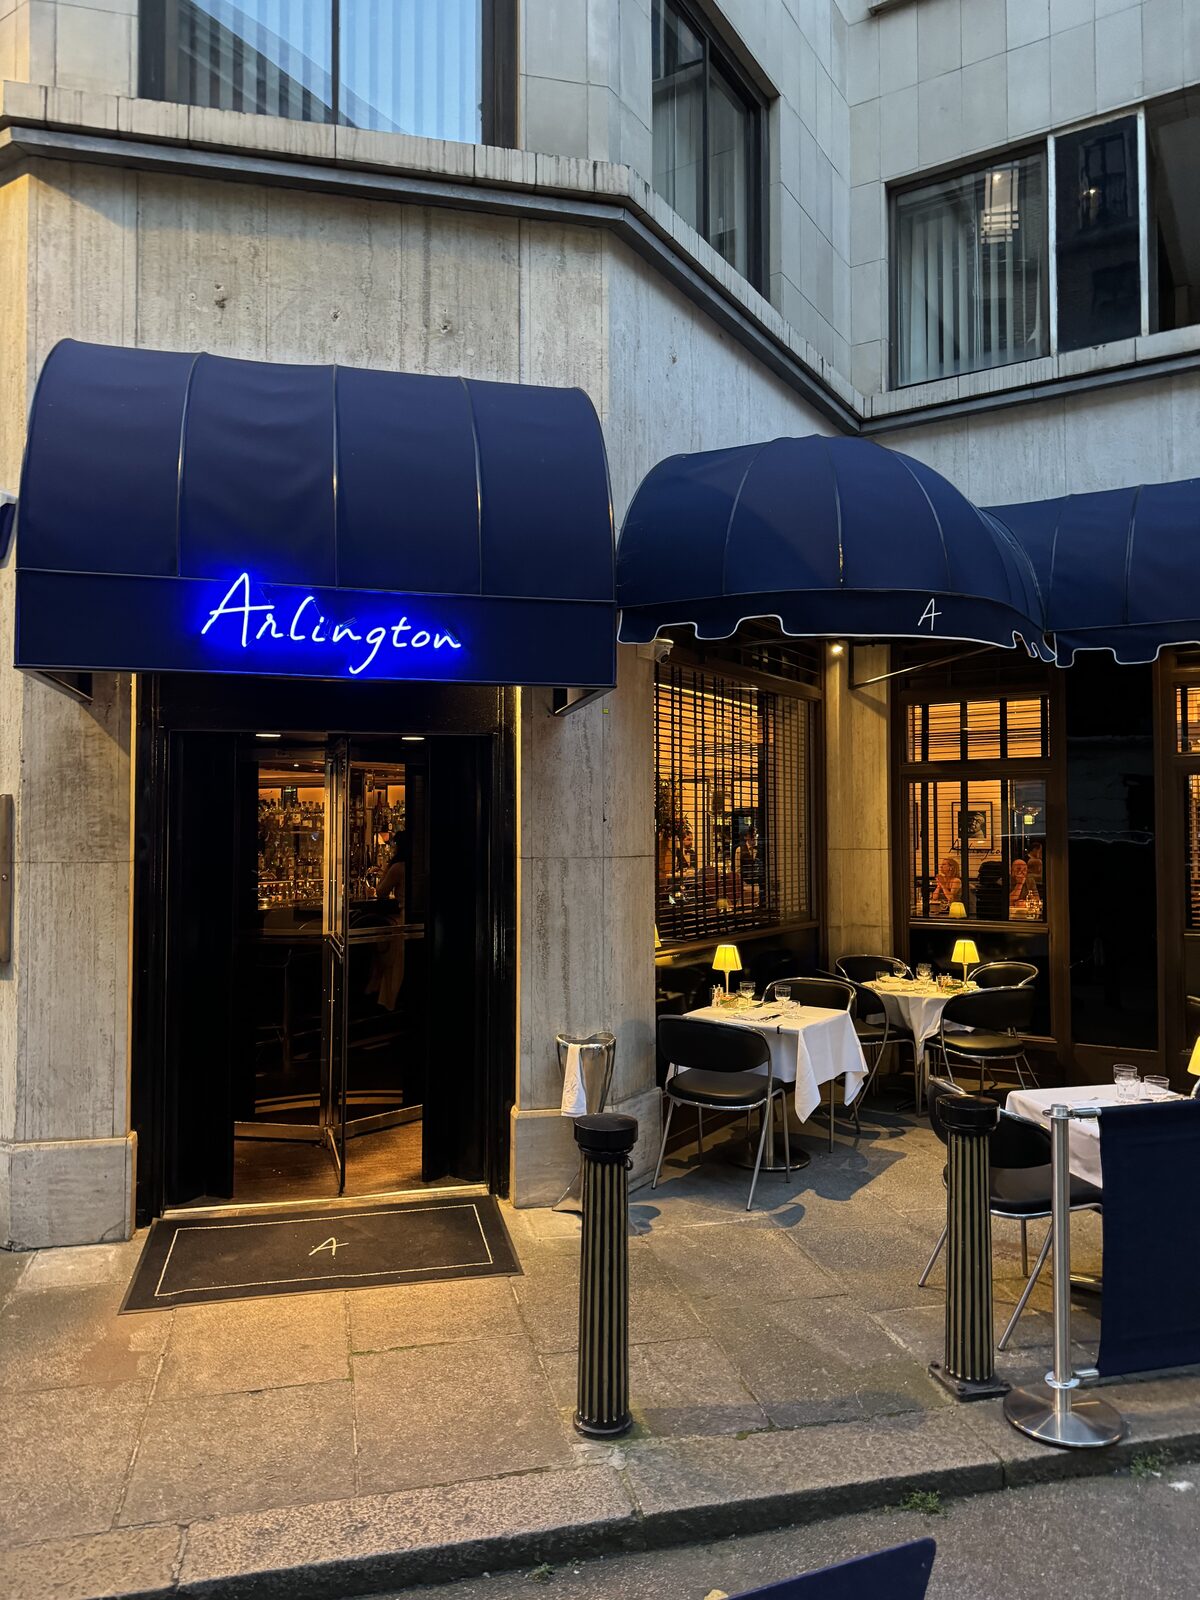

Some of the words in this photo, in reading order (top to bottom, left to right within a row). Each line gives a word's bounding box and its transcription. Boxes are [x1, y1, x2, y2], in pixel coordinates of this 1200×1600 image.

[201, 572, 462, 674] Arlington
[917, 597, 943, 631] A
[308, 1236, 350, 1256] A
